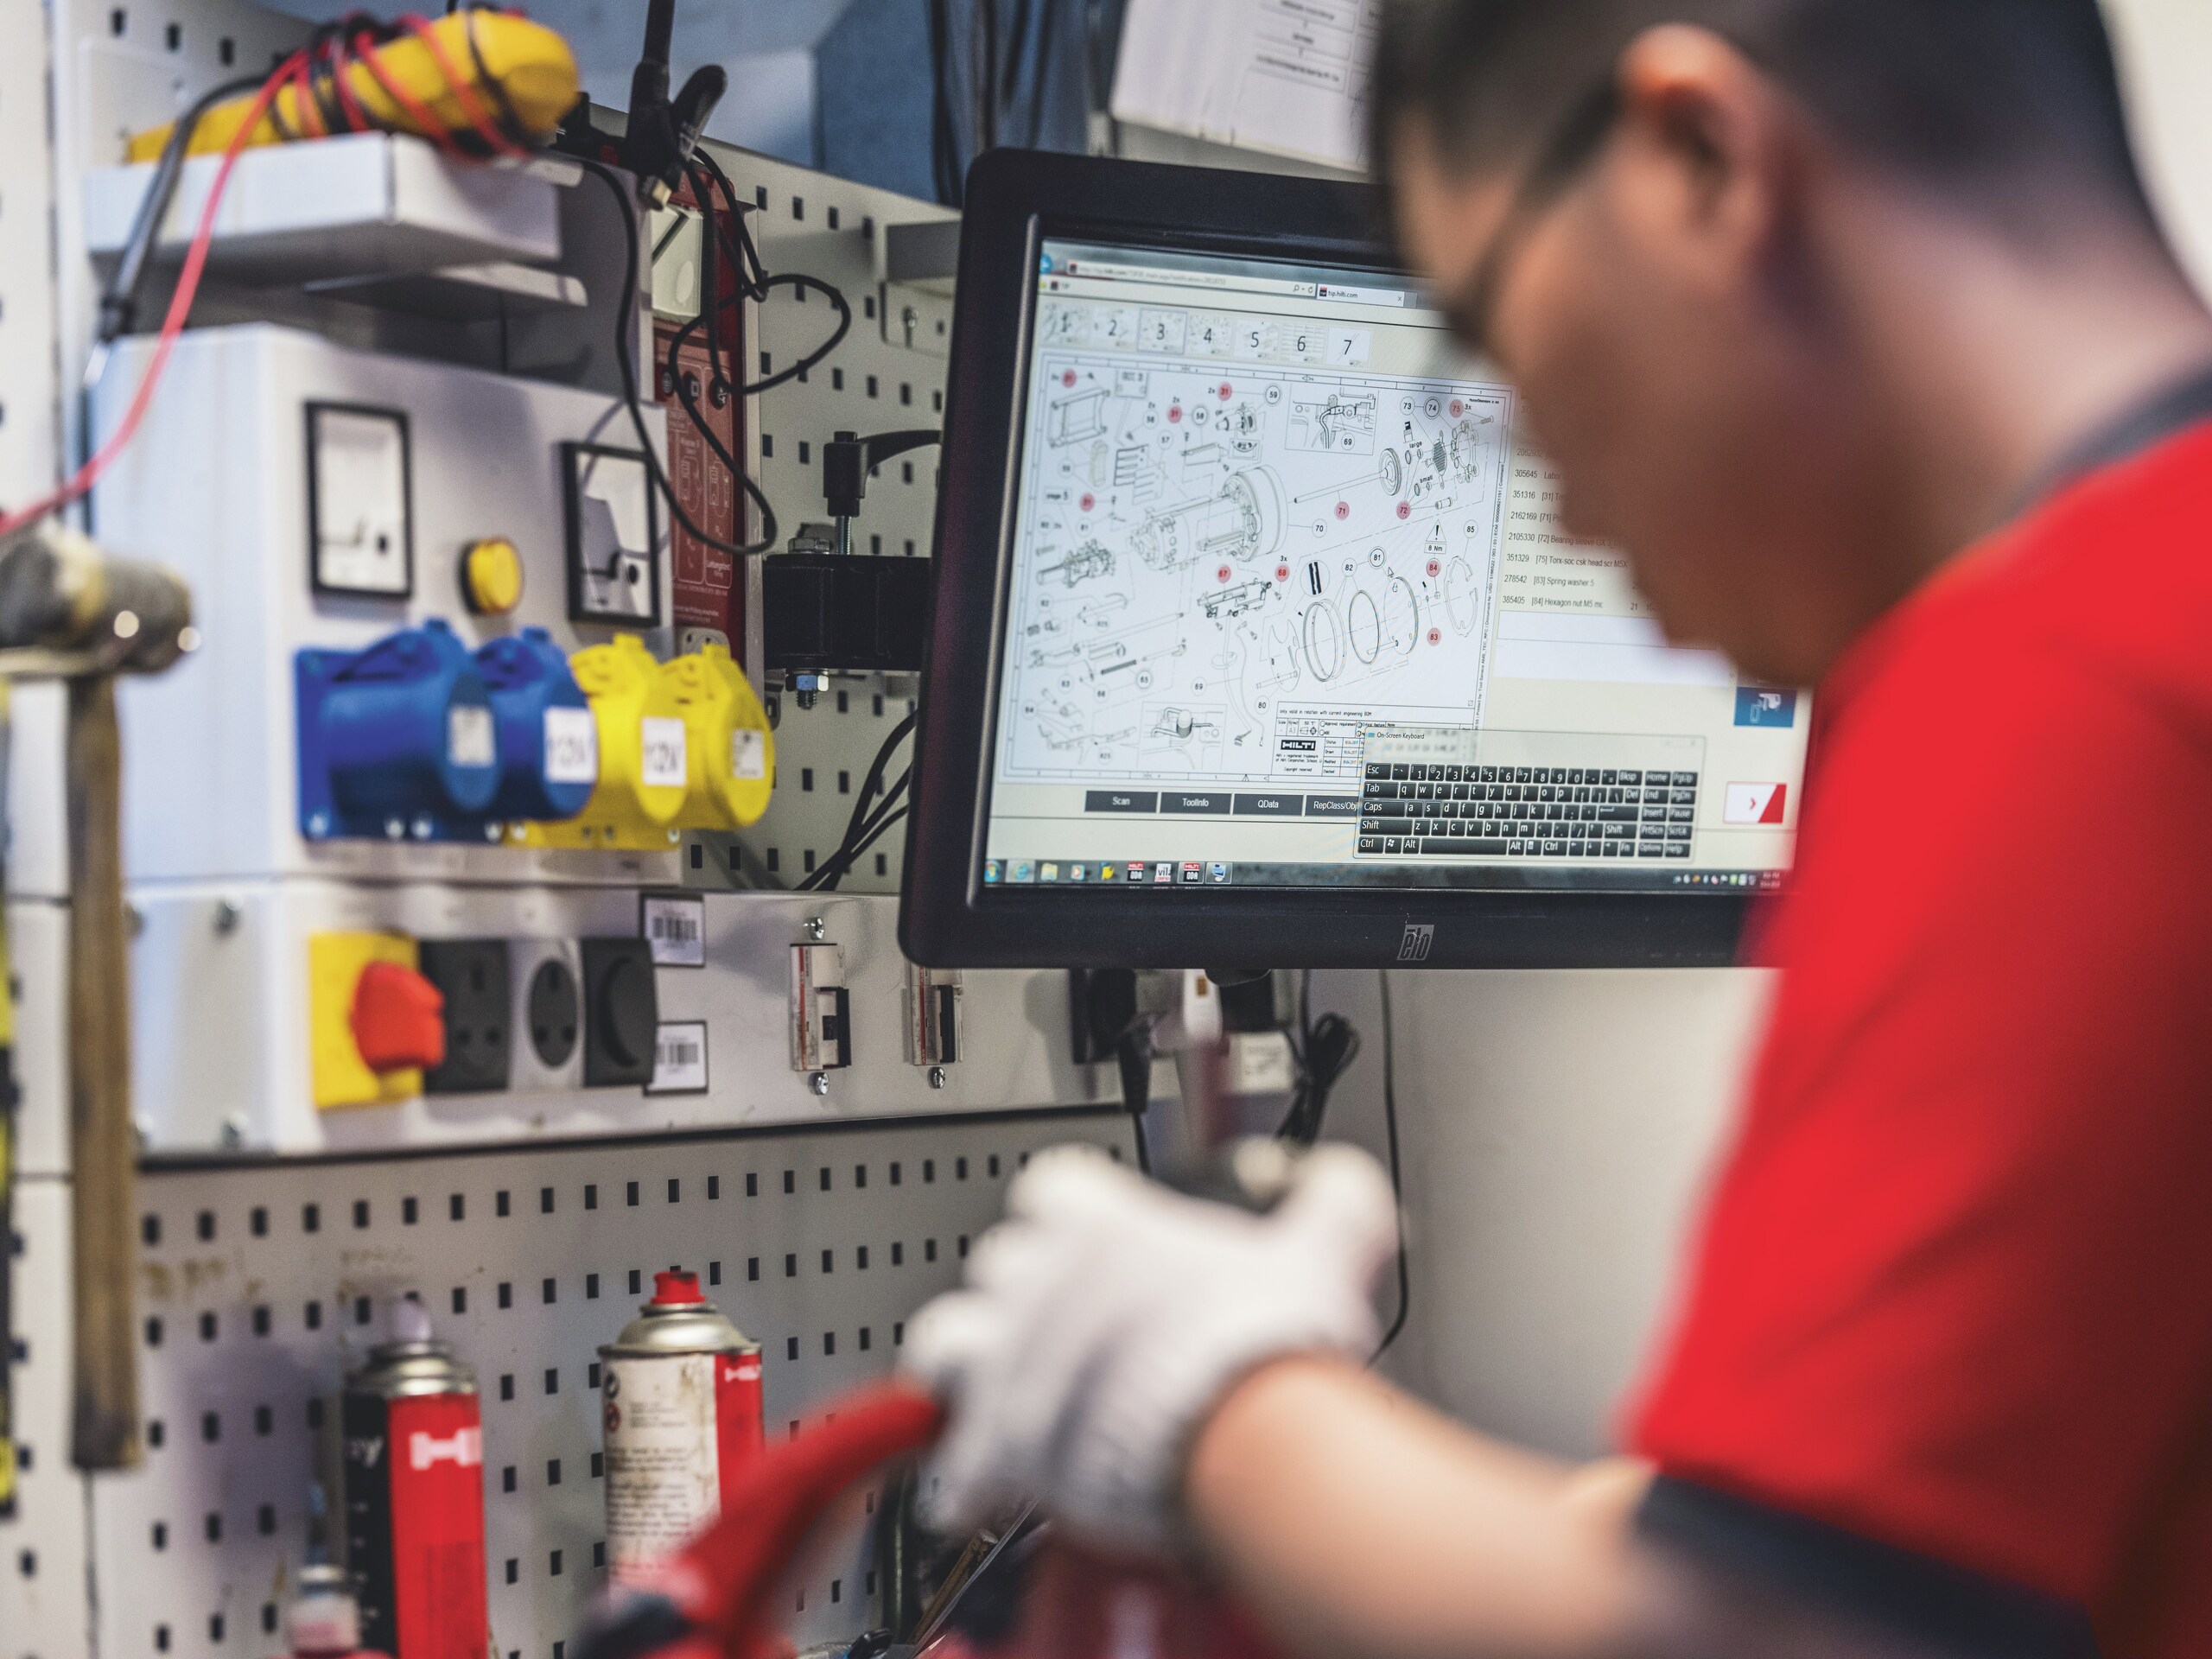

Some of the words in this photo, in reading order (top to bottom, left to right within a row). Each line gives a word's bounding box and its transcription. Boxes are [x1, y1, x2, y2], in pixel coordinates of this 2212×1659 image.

[1108, 319, 1117, 337] 2
[1157, 323, 1165, 340] 3
[1203, 328, 1212, 344] 4
[1250, 331, 1259, 347] 5
[1297, 336, 1306, 352] 6
[1343, 339, 1352, 355] 7
[1428, 404, 1437, 412] 74
[1409, 440, 1422, 449] large
[1419, 475, 1433, 483] small
[1515, 469, 1538, 478] 305645
[1513, 490, 1536, 500] 351316
[1542, 492, 1553, 501] [31]
[1511, 512, 1537, 521] 2162169
[1540, 512, 1552, 522] [71]
[1508, 532, 1535, 542] 2105330
[1538, 534, 1550, 543] [72]
[1551, 535, 1574, 546] Bearing
[1507, 553, 1529, 563] 351329
[1536, 555, 1548, 564] [75]
[1576, 558, 1586, 566] csk
[1504, 575, 1527, 584] 278542
[1534, 576, 1546, 586] [83]
[1547, 577, 1567, 588] Spring
[1502, 595, 1525, 604] 385405
[1532, 597, 1543, 607] [84]
[1545, 598, 1571, 607] Hexagon
[1282, 741, 1315, 749] HILTI
[1367, 766, 1379, 774] Esc
[1417, 771, 1422, 779] 1
[1435, 771, 1441, 780] 2
[1453, 772, 1458, 780] 3
[1470, 772, 1476, 780] 4
[1488, 772, 1493, 780] 5
[1505, 772, 1511, 781] 6
[1540, 773, 1545, 782] 8
[1557, 774, 1563, 782] 9
[1574, 774, 1580, 783] 0
[1645, 773, 1667, 782] Home
[1366, 783, 1379, 792] Tab
[1401, 786, 1407, 795] q
[1489, 788, 1495, 797] y
[1524, 787, 1527, 795] i
[1558, 789, 1564, 799] p
[1625, 791, 1638, 799] Del
[1644, 791, 1659, 799] End
[1112, 797, 1130, 806] Scan
[1182, 798, 1209, 807] ToolInfo
[1257, 799, 1279, 809] QData
[1363, 801, 1382, 812] Caps
[1444, 803, 1450, 812] d
[1461, 804, 1466, 812] f
[1479, 806, 1484, 815] g
[1496, 804, 1502, 813] h
[1513, 805, 1517, 816] j
[1531, 805, 1536, 814] k
[1670, 809, 1691, 818] Pause
[1362, 821, 1379, 830] Shift
[1486, 822, 1491, 831] b
[1606, 824, 1623, 834] Shift
[1360, 839, 1374, 848] Ctrl
[1405, 840, 1416, 849] Alt
[1510, 842, 1521, 850] Alt
[1544, 841, 1558, 851] Ctrl
[1621, 843, 1631, 852] Fn
[1400, 927, 1431, 959] elo
